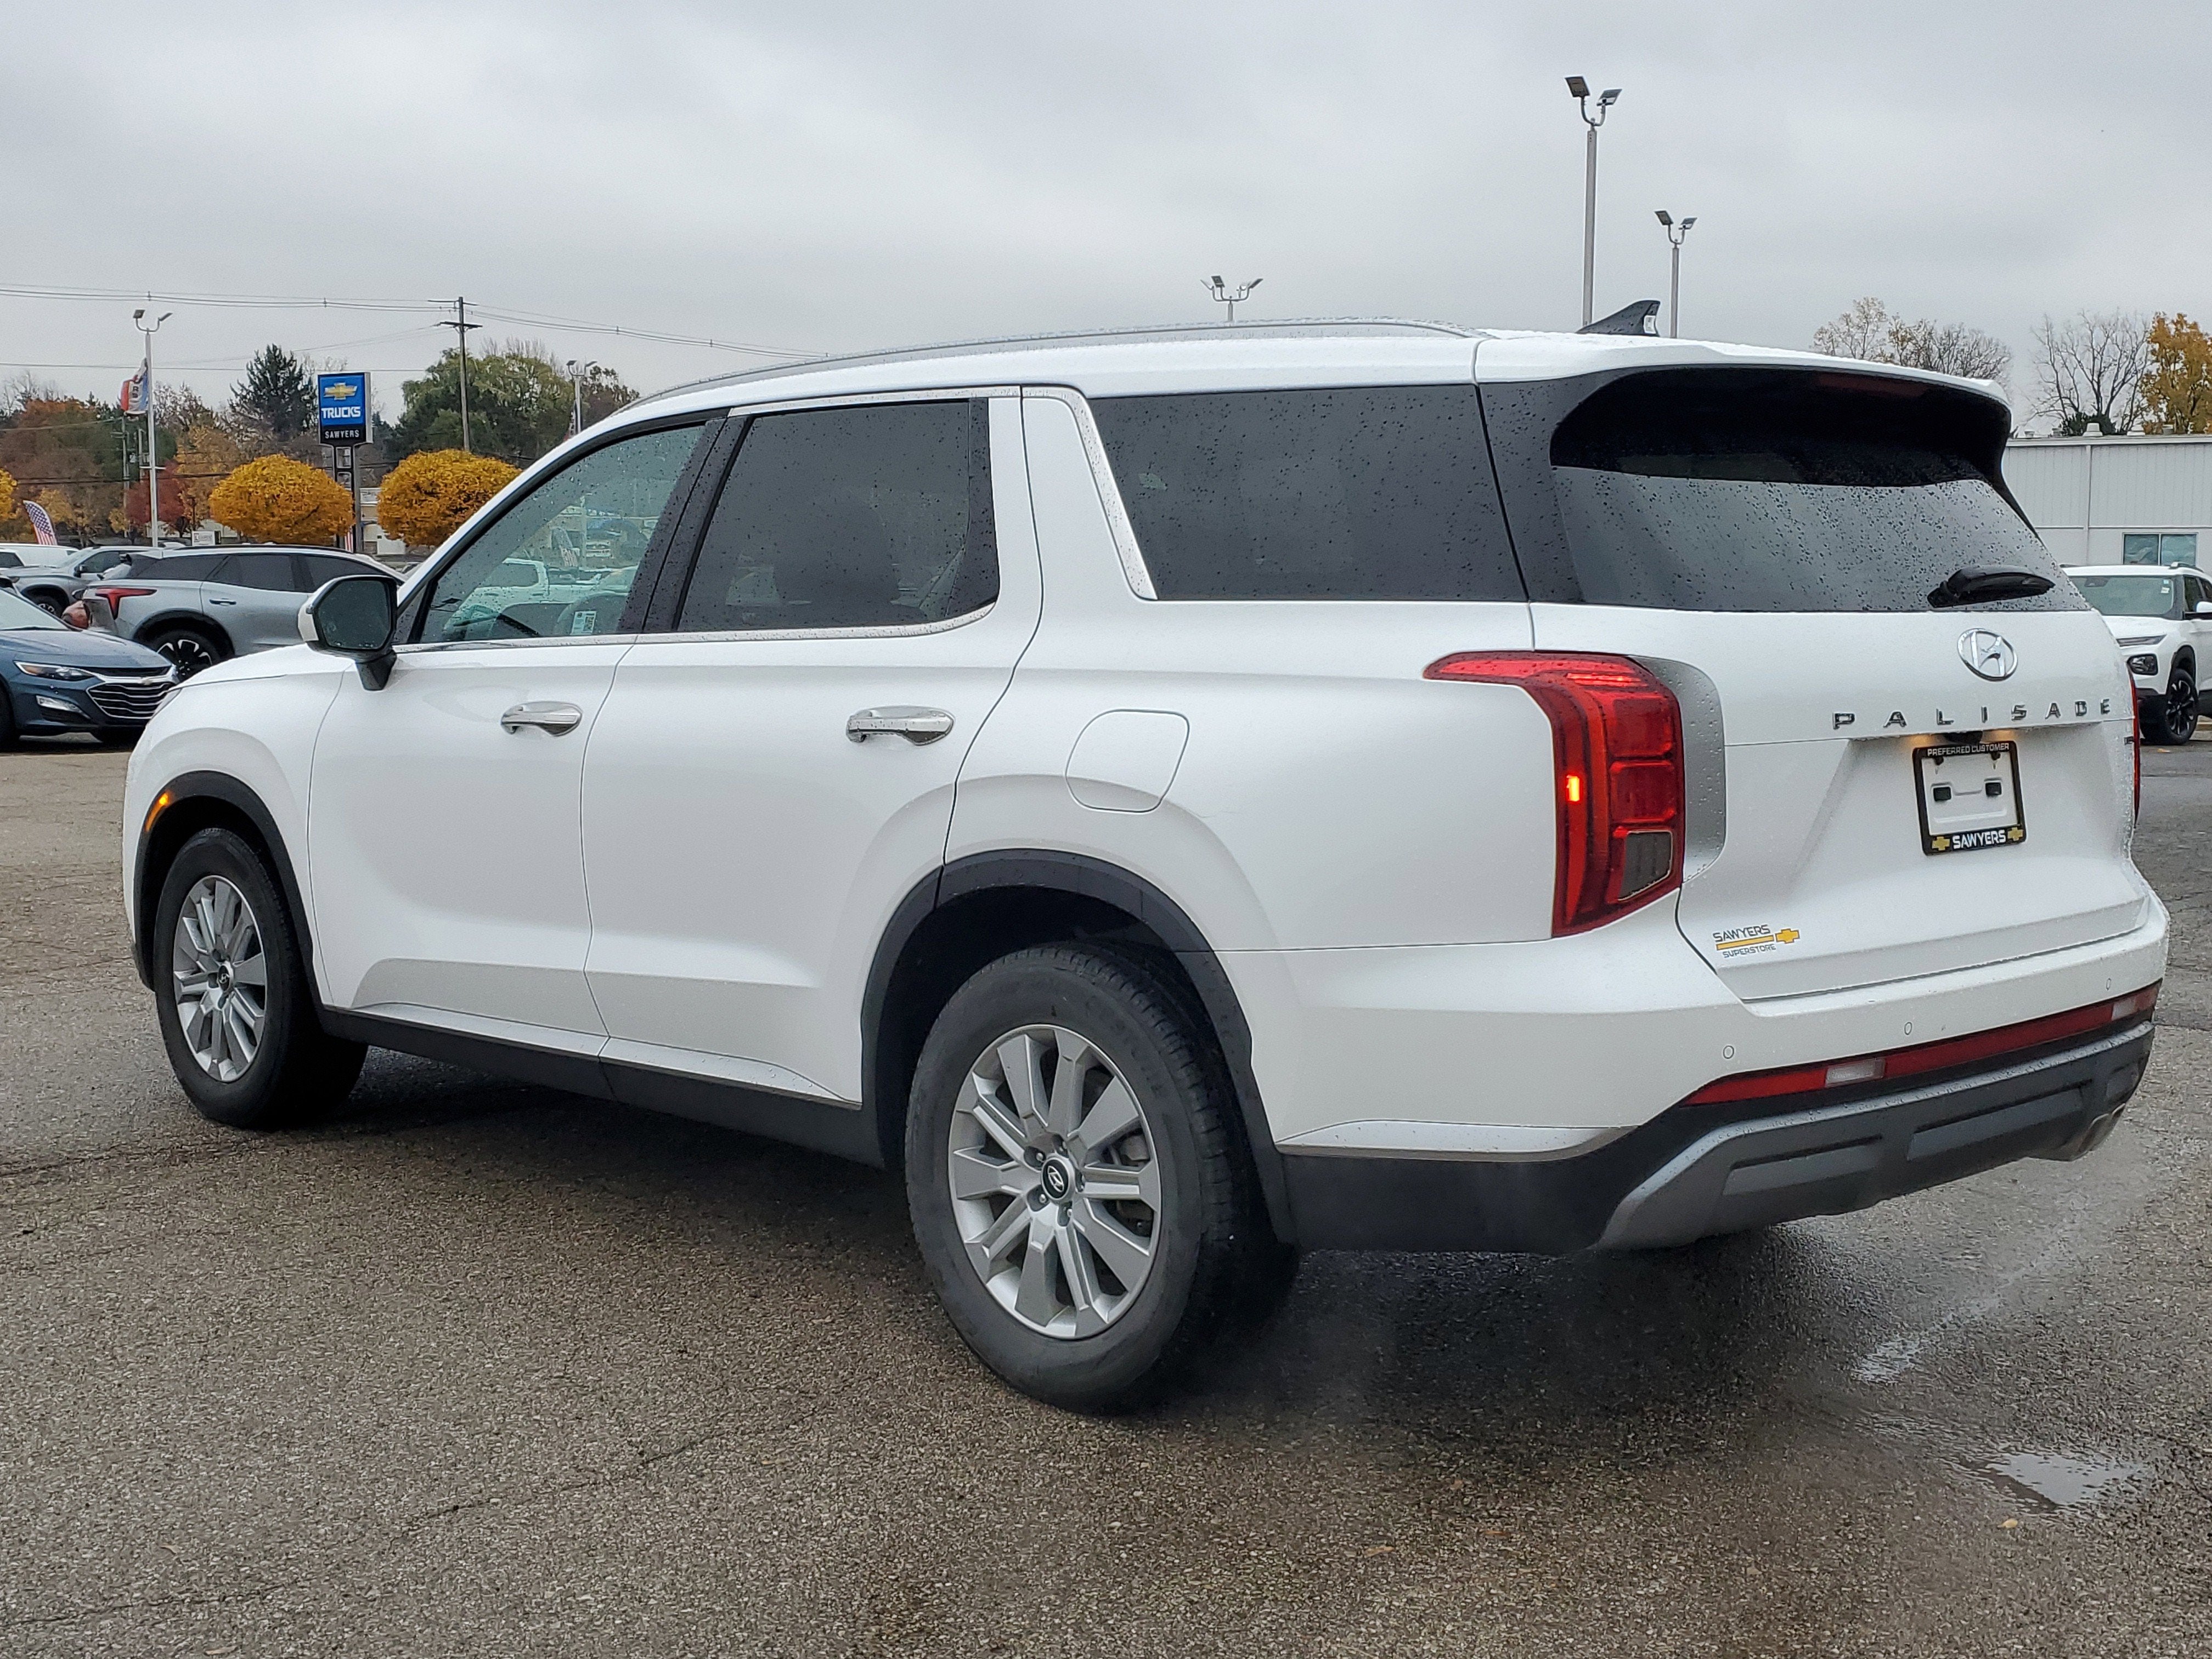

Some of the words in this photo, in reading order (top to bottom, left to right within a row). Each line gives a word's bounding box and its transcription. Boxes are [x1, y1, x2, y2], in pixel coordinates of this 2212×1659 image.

[321, 406, 361, 419] TRUCKS
[325, 430, 359, 439] SAWYERS
[1833, 698, 2112, 730] PALISADE
[1927, 745, 1970, 757] PREFERRED
[1971, 742, 2010, 753] CUSTOMER
[1952, 830, 2007, 850] SAWYERS
[1713, 924, 1771, 943] SAWYERS
[1722, 944, 1776, 958] SUPERSTORE
